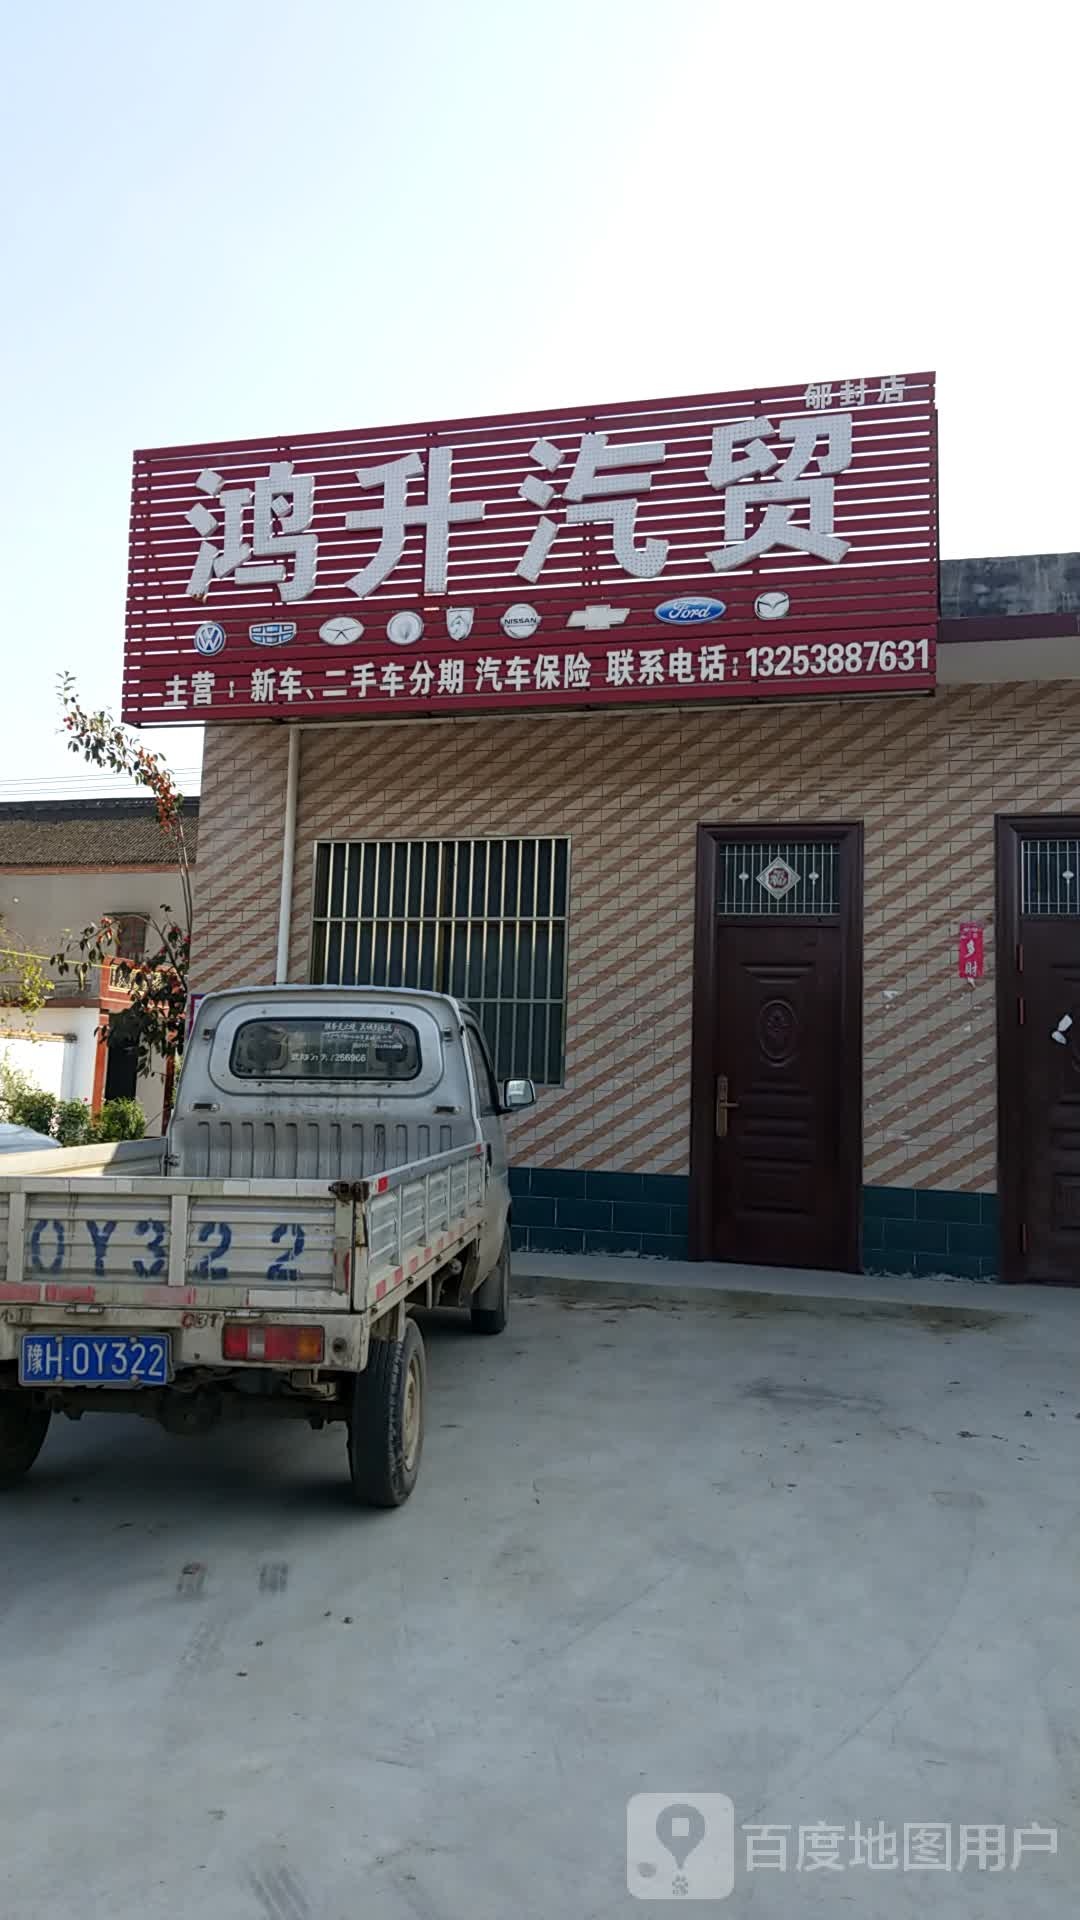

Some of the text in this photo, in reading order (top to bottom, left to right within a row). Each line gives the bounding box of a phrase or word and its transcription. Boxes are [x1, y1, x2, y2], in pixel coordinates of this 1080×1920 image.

[184, 413, 853, 604] 鸿升汽贸
[504, 616, 537, 626] NISSAN
[669, 601, 711, 621] Ford
[475, 651, 591, 692] 汽车保险
